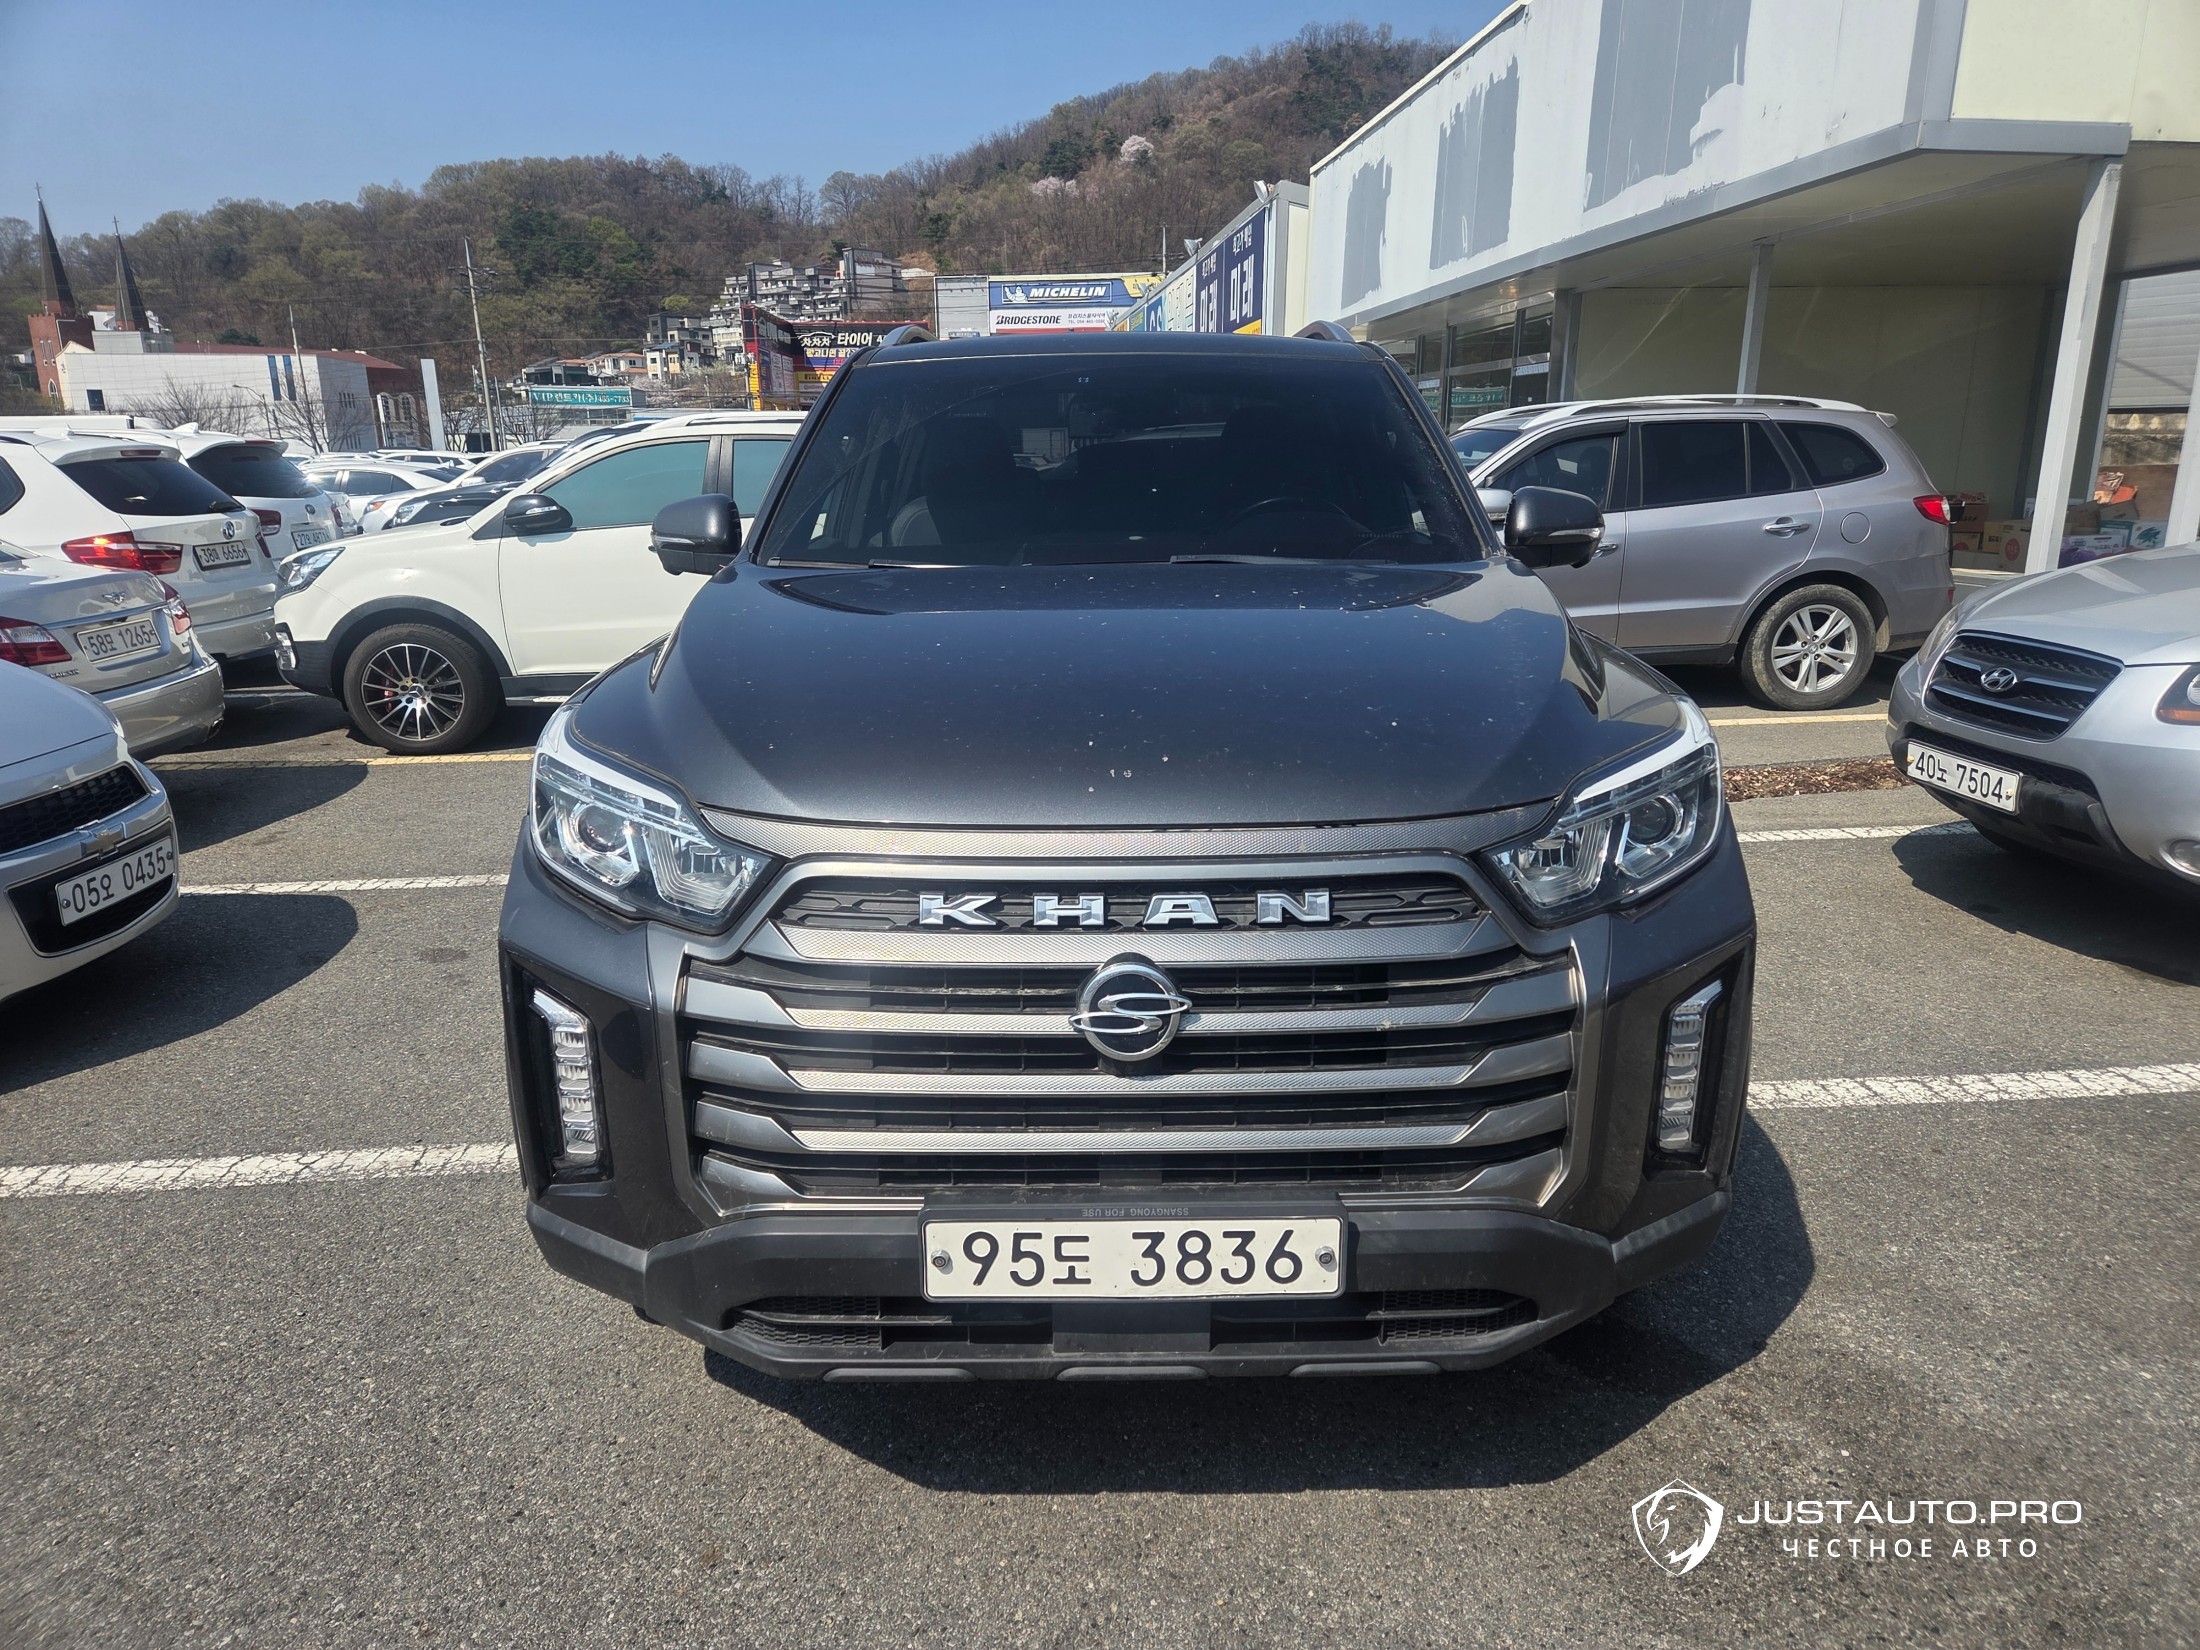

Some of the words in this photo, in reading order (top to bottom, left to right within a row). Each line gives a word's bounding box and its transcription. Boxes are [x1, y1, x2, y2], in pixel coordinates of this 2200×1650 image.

[1029, 286, 1107, 298] MICHELIN
[1230, 253, 1255, 324] 미래
[995, 315, 1061, 325] BRIDGESTONE
[801, 337, 832, 347] 차차차
[837, 332, 873, 346] 타이어
[222, 544, 244, 561] 6656
[118, 625, 151, 650] 1265
[1915, 751, 1948, 784] 40노
[1956, 763, 2004, 803] 7504
[72, 874, 115, 914] 05오
[122, 846, 166, 891] 0435
[918, 889, 1332, 926] KHAN
[1082, 1208, 1102, 1217] USE
[1105, 1208, 1125, 1217] FOR
[1130, 1207, 1189, 1216] SSANGYONG
[962, 1231, 1092, 1287] 95도
[1130, 1229, 1303, 1287] 3836
